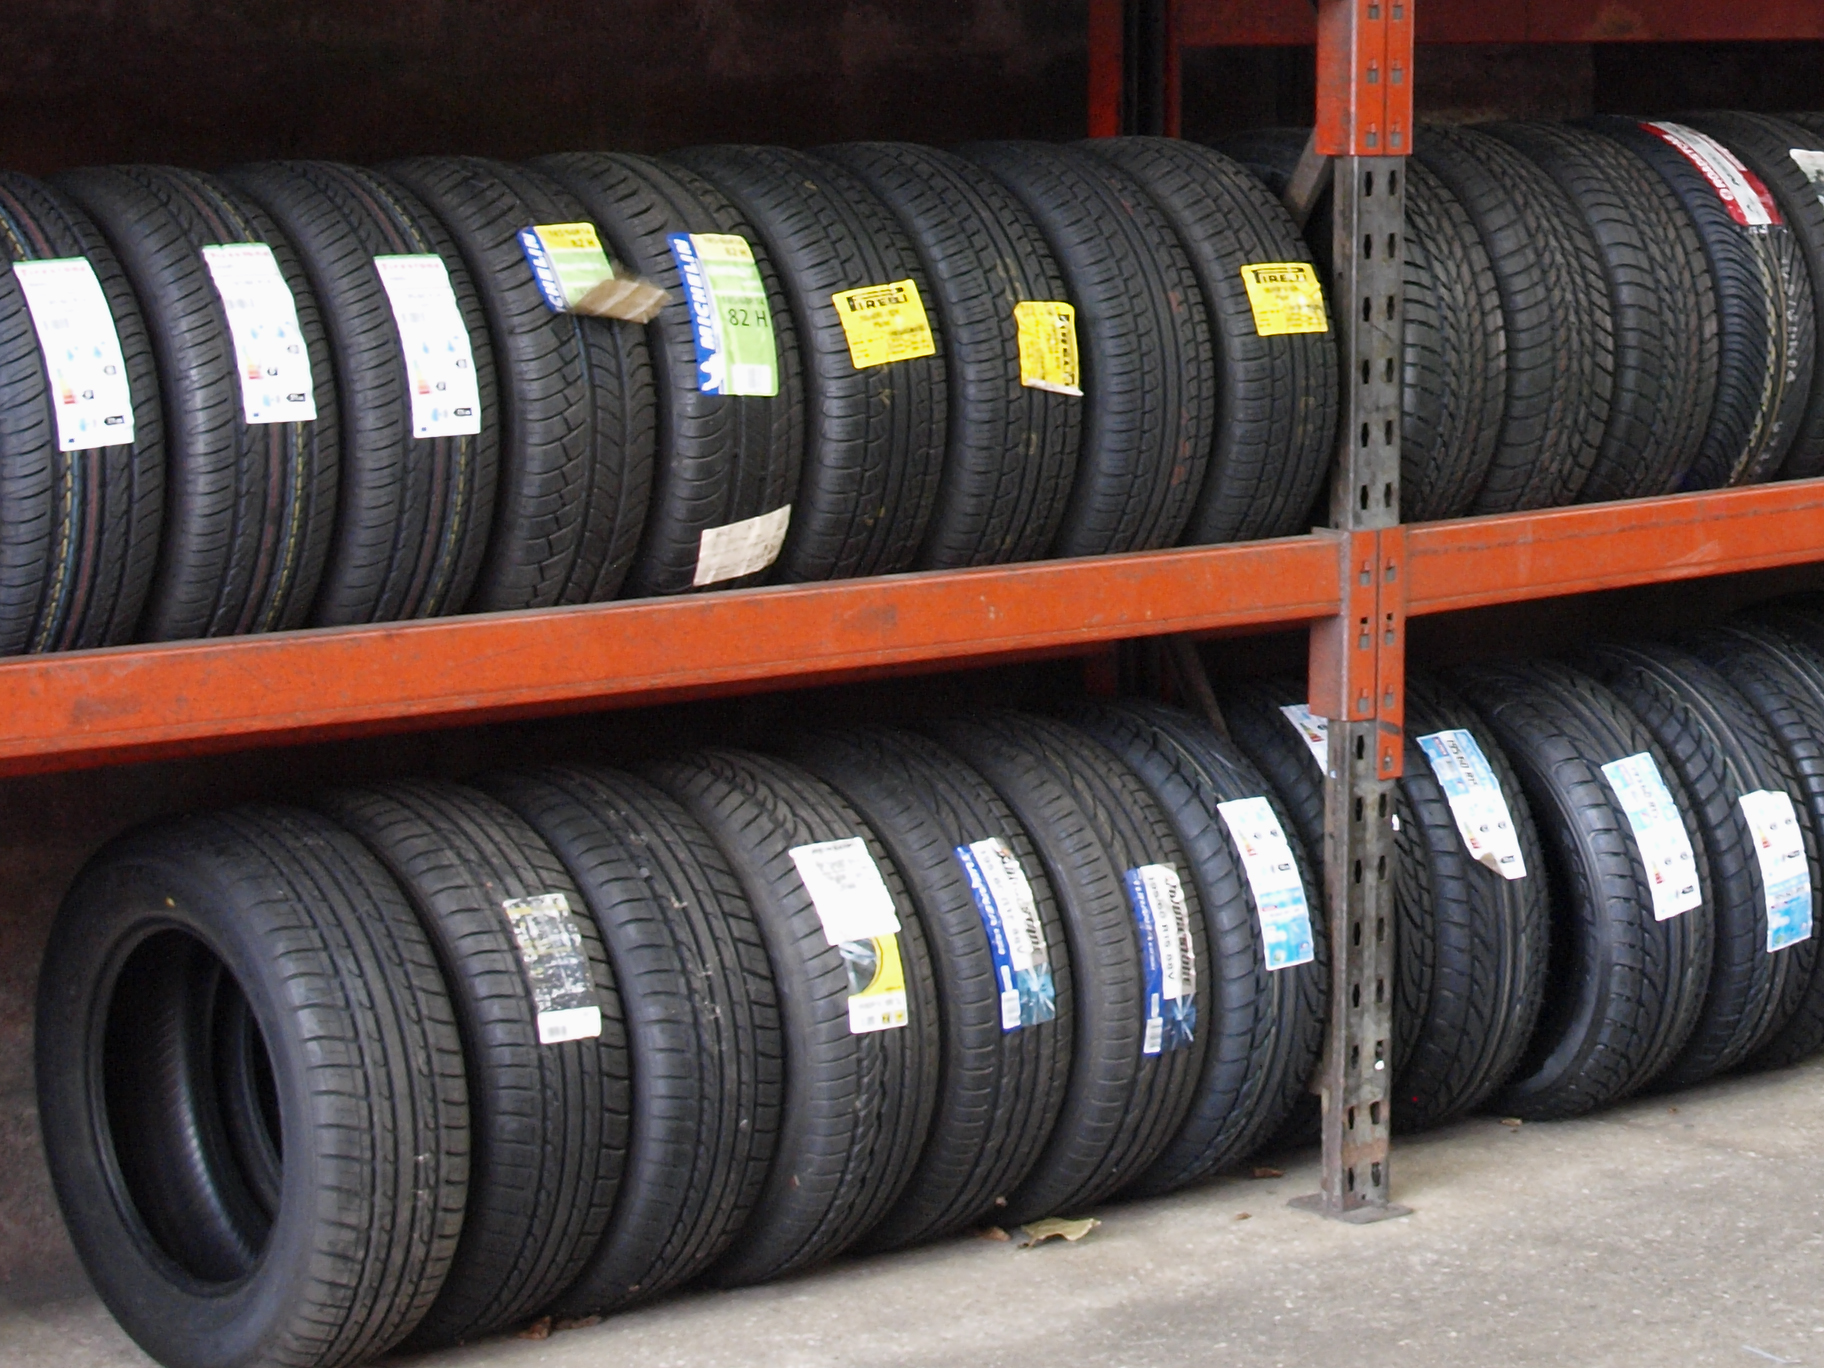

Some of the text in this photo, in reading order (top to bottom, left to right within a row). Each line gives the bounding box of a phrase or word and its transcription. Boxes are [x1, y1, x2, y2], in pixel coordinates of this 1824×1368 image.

[673, 238, 717, 351] MICHELIN
[728, 308, 769, 327] 82 H
